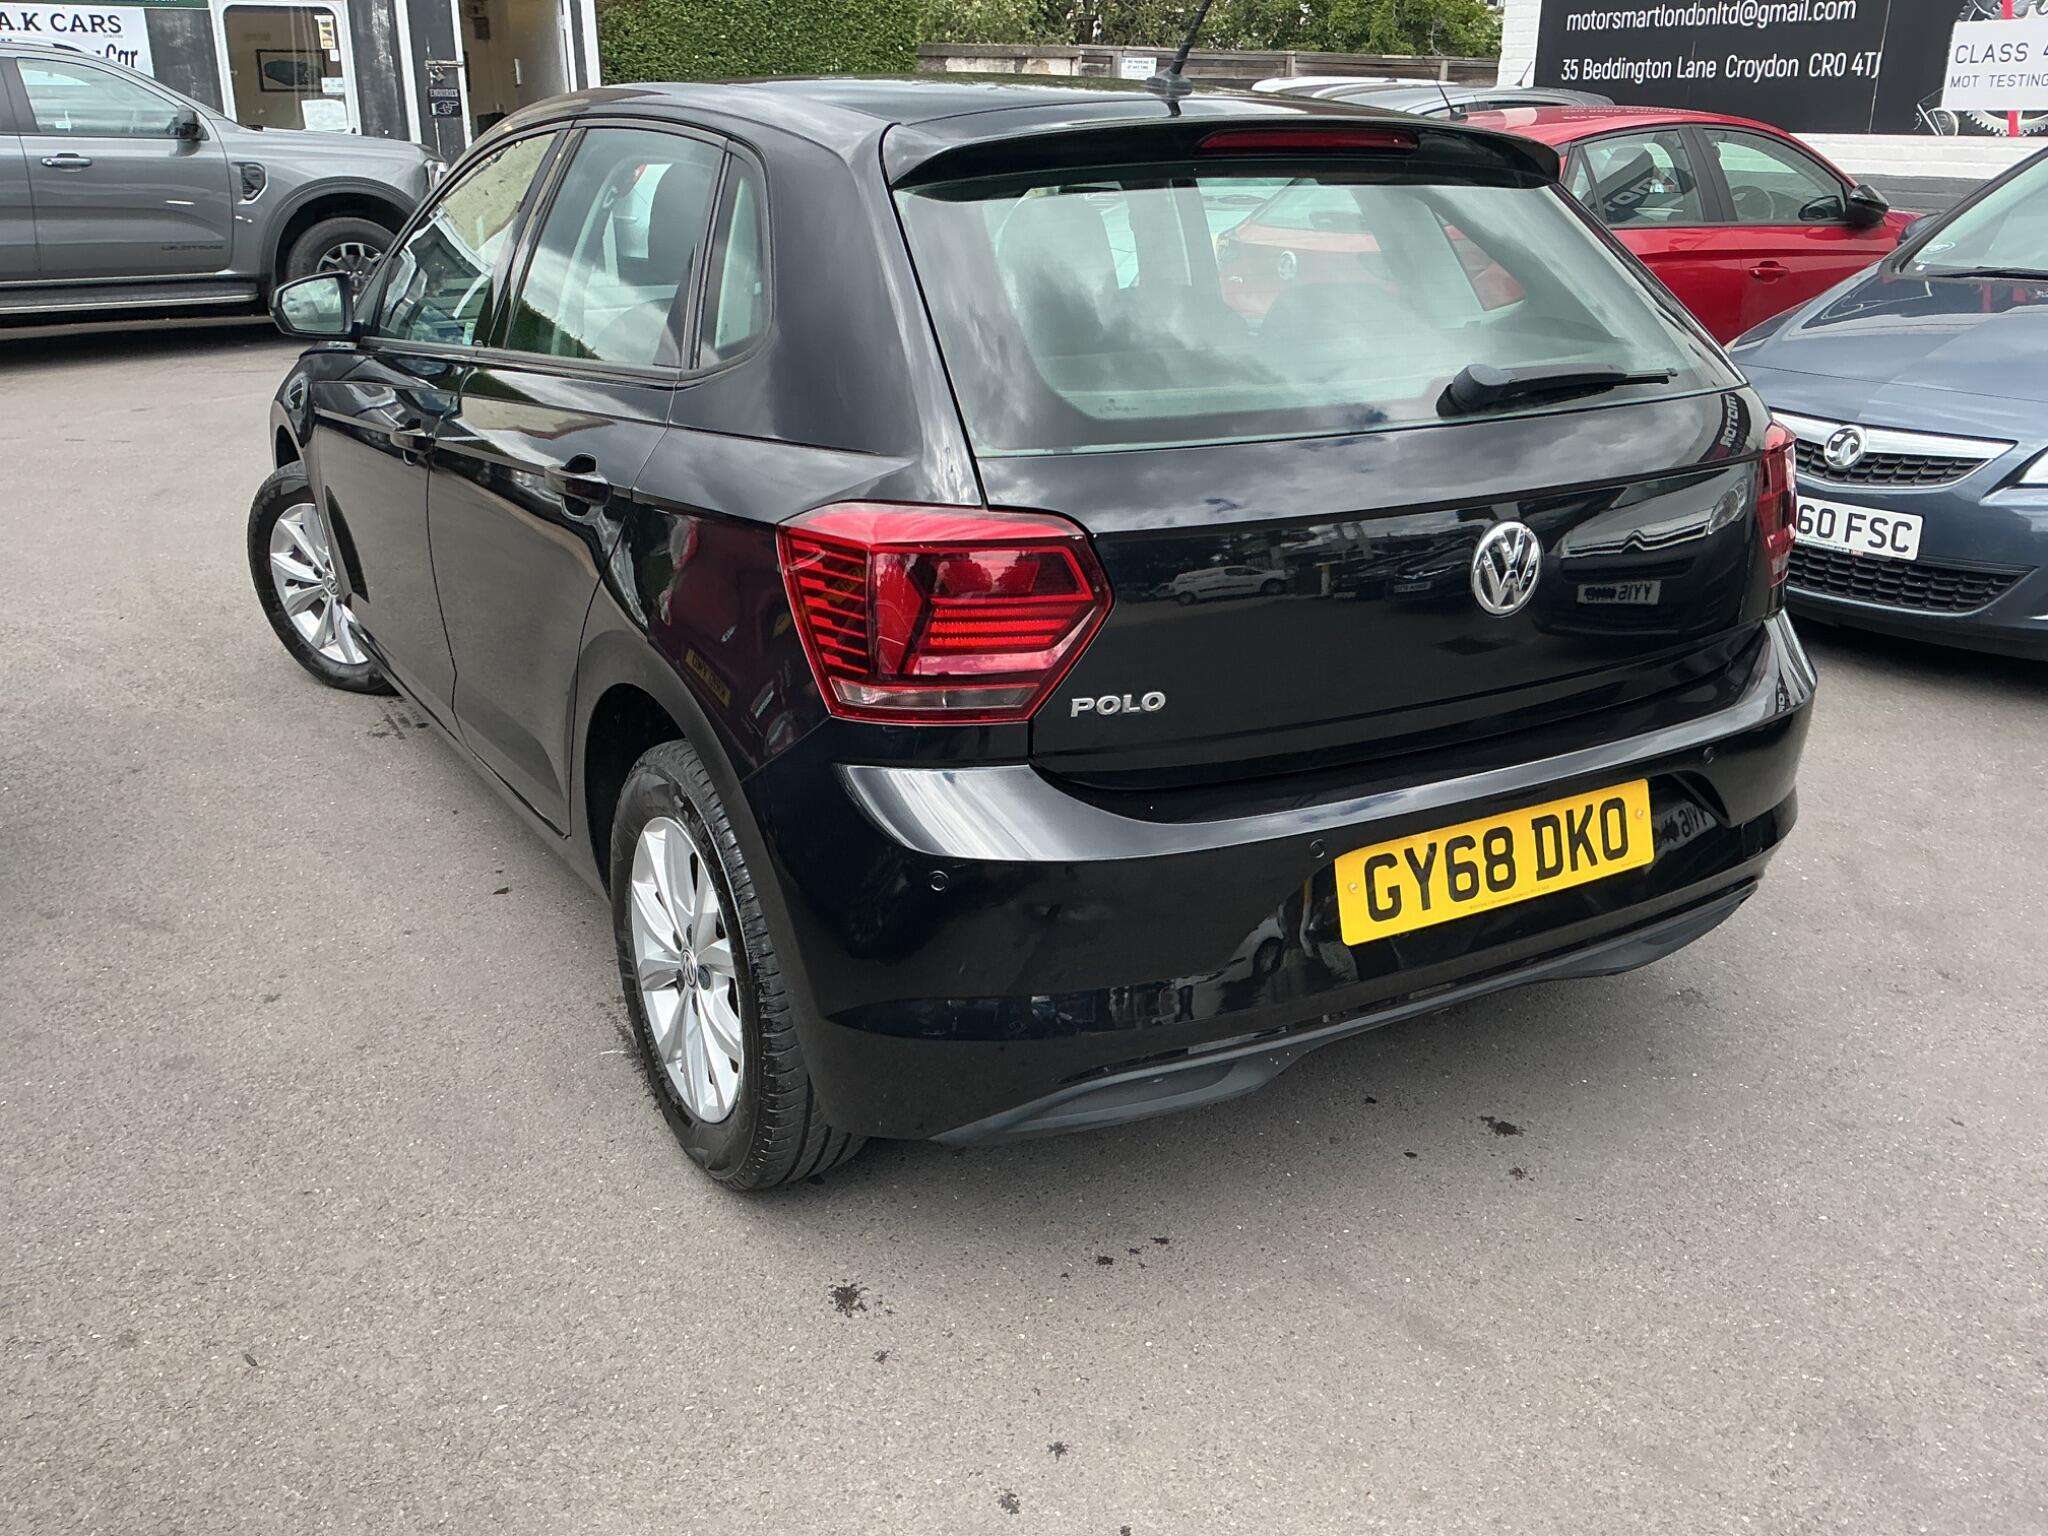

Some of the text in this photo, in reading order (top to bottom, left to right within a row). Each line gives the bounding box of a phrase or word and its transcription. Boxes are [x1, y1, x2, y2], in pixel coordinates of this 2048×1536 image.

[50, 14, 122, 33] CARS
[1566, 0, 1857, 31] motorsmartlondonltd@gmail.com
[1955, 43, 2029, 64] CLASS
[1561, 59, 1579, 80] 35
[1582, 57, 1671, 84] Beddington
[1677, 56, 1717, 78] Lane
[1725, 54, 1799, 83] Croydon
[1851, 52, 1883, 78] 4TJ
[1950, 75, 1980, 88] MOT
[1844, 512, 1912, 553] FSC
[1070, 691, 1166, 717] POLO
[1364, 797, 1629, 923] GY68 DKO
